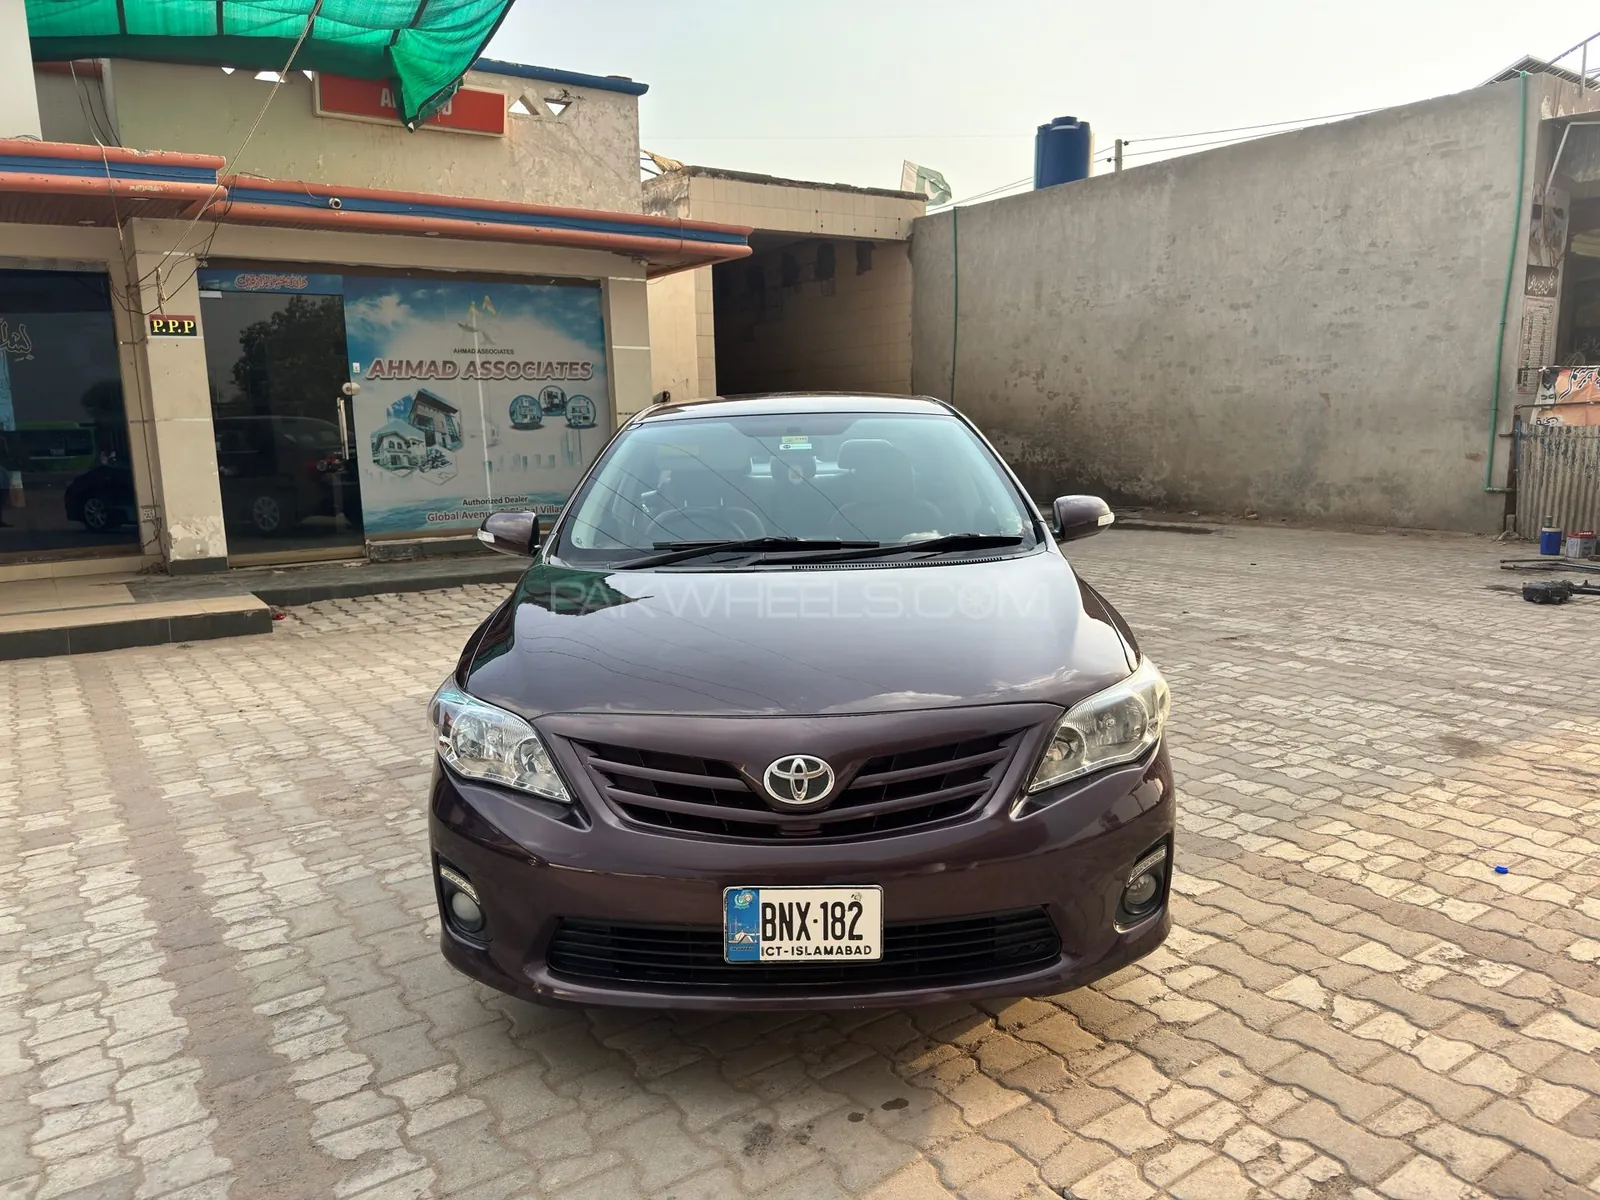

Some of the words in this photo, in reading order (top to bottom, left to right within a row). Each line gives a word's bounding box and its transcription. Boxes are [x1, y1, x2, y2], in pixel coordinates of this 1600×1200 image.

[153, 319, 194, 333] P.P.P
[367, 358, 459, 379] AHMAD
[461, 360, 593, 381] ASSOCIATES
[462, 497, 503, 506] Authorized
[505, 496, 529, 504] Dealer
[427, 511, 459, 522] Global
[462, 511, 493, 520] Avenu
[761, 945, 872, 956] ICT-ISLAMABAD
